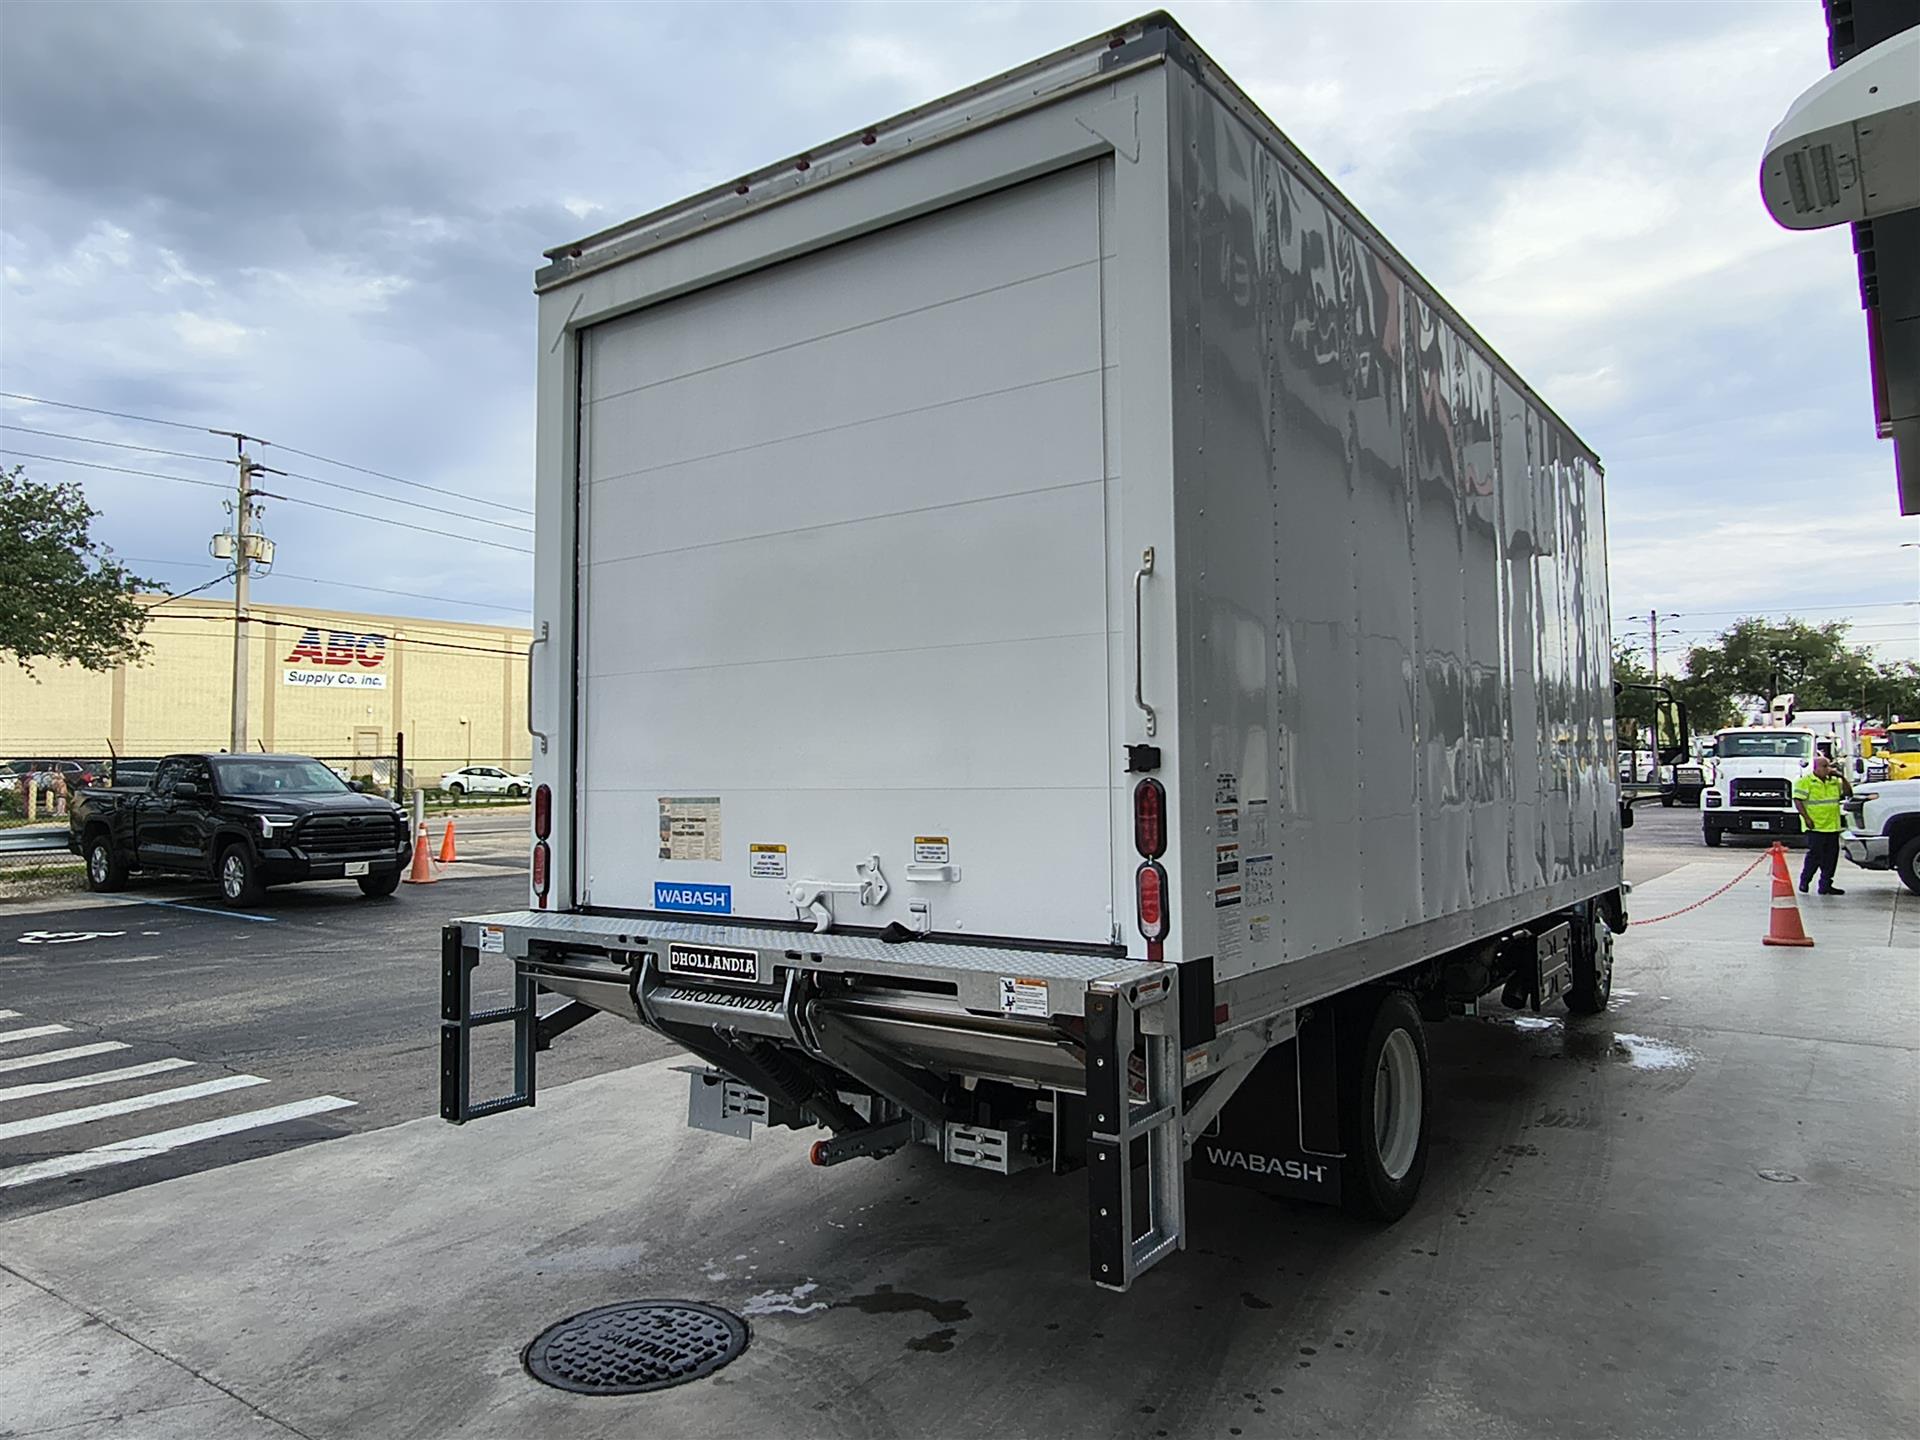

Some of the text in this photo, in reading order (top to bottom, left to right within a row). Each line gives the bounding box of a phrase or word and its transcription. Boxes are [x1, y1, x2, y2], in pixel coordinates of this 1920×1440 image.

[284, 628, 386, 667] ABC
[288, 671, 335, 685] Supply
[657, 889, 726, 907] WABASH
[671, 951, 755, 974] DHOLLANDIA
[670, 988, 782, 1013] DHOLLANDIA
[1206, 1145, 1323, 1183] WABASH
